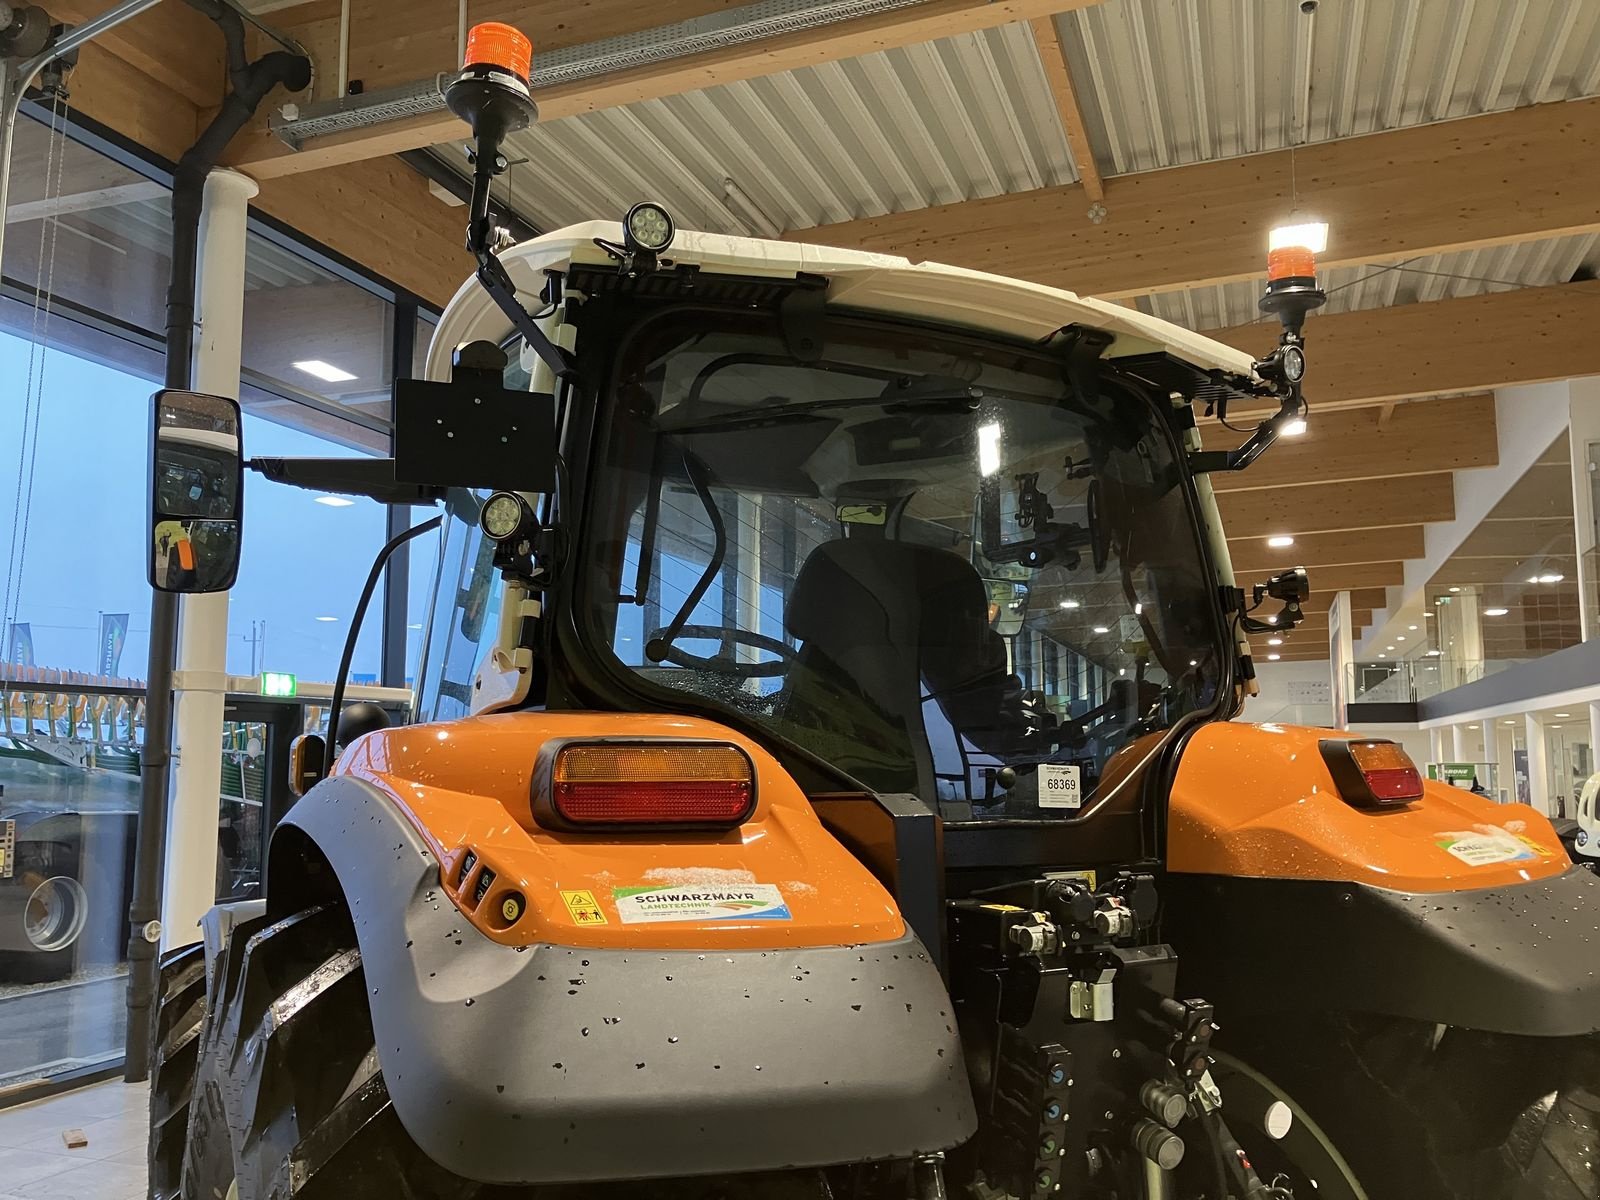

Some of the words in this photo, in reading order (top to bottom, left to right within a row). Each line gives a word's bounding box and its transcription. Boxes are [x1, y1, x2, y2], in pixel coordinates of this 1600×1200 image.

[1047, 778, 1076, 790] 68369
[635, 892, 755, 904] SCHWARZMAYR
[640, 901, 712, 910] LANDTECHNIK
